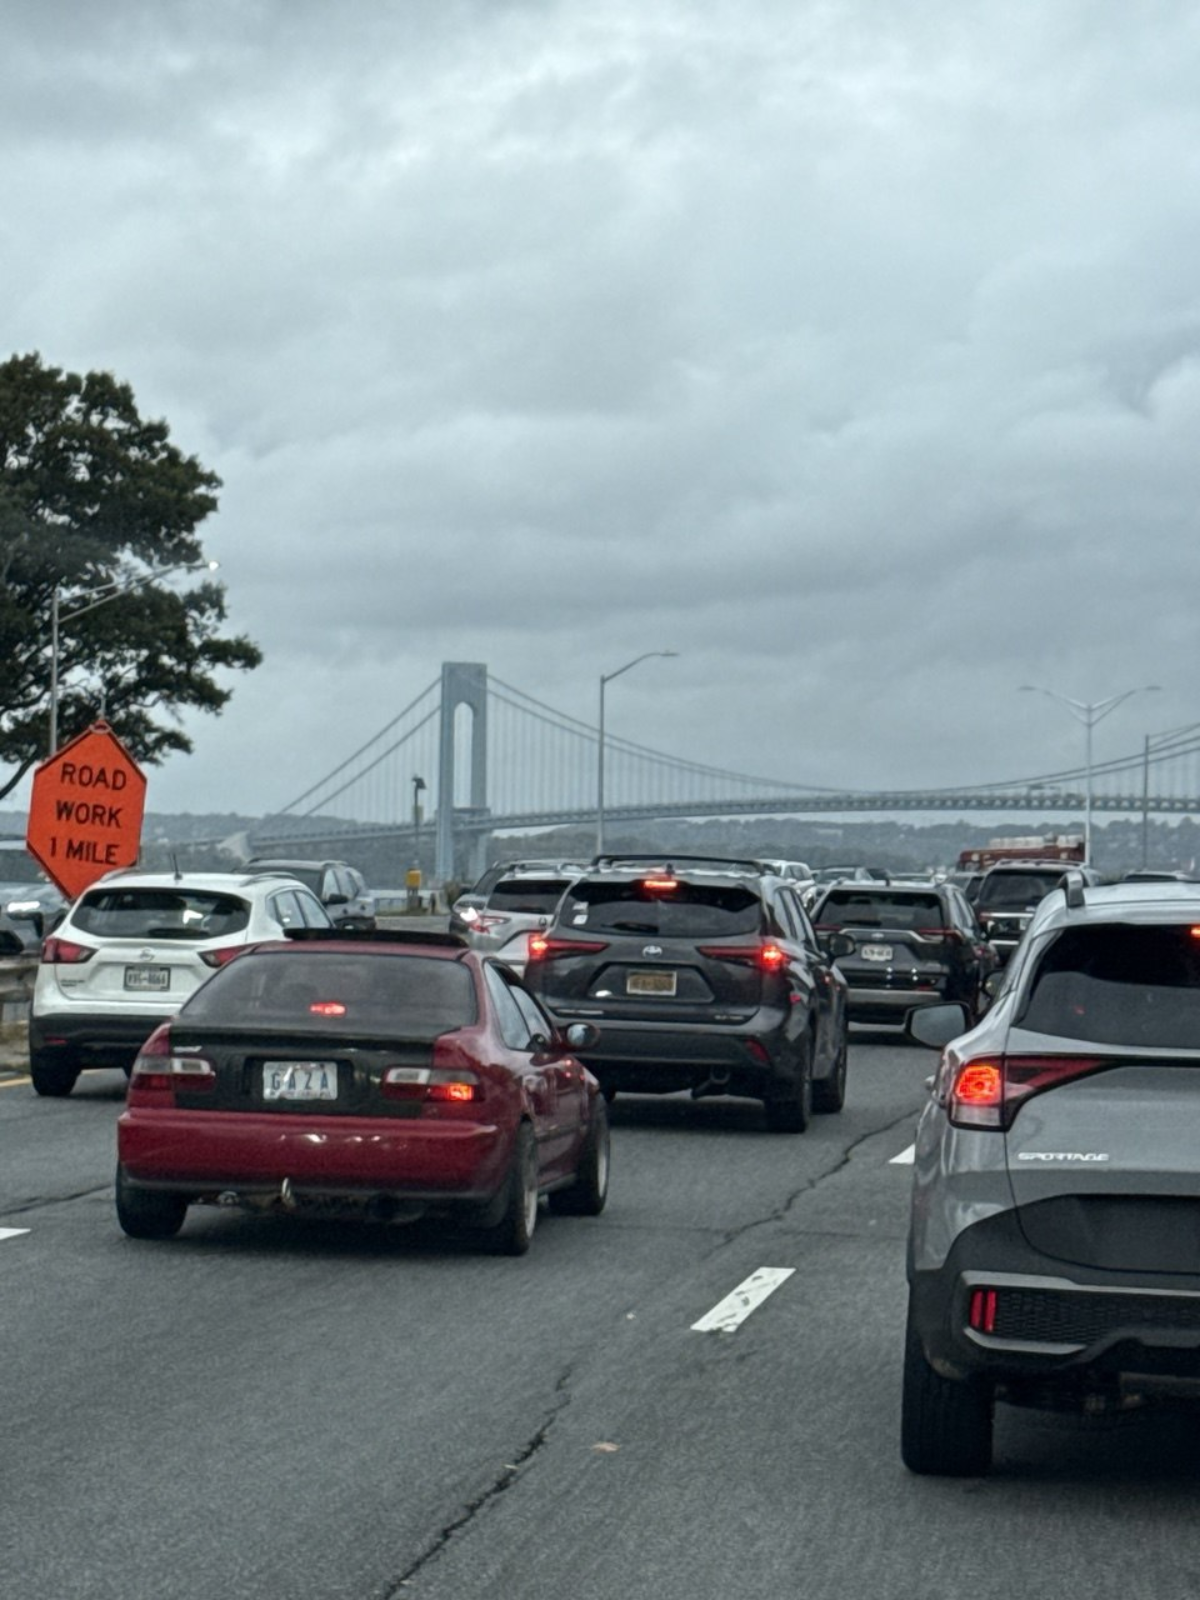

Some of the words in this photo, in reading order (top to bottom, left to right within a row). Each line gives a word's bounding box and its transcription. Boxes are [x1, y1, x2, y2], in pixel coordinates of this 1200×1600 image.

[61, 762, 127, 791] ROAD
[56, 800, 123, 829] WORK
[50, 837, 57, 857] 1
[65, 839, 121, 866] MILE
